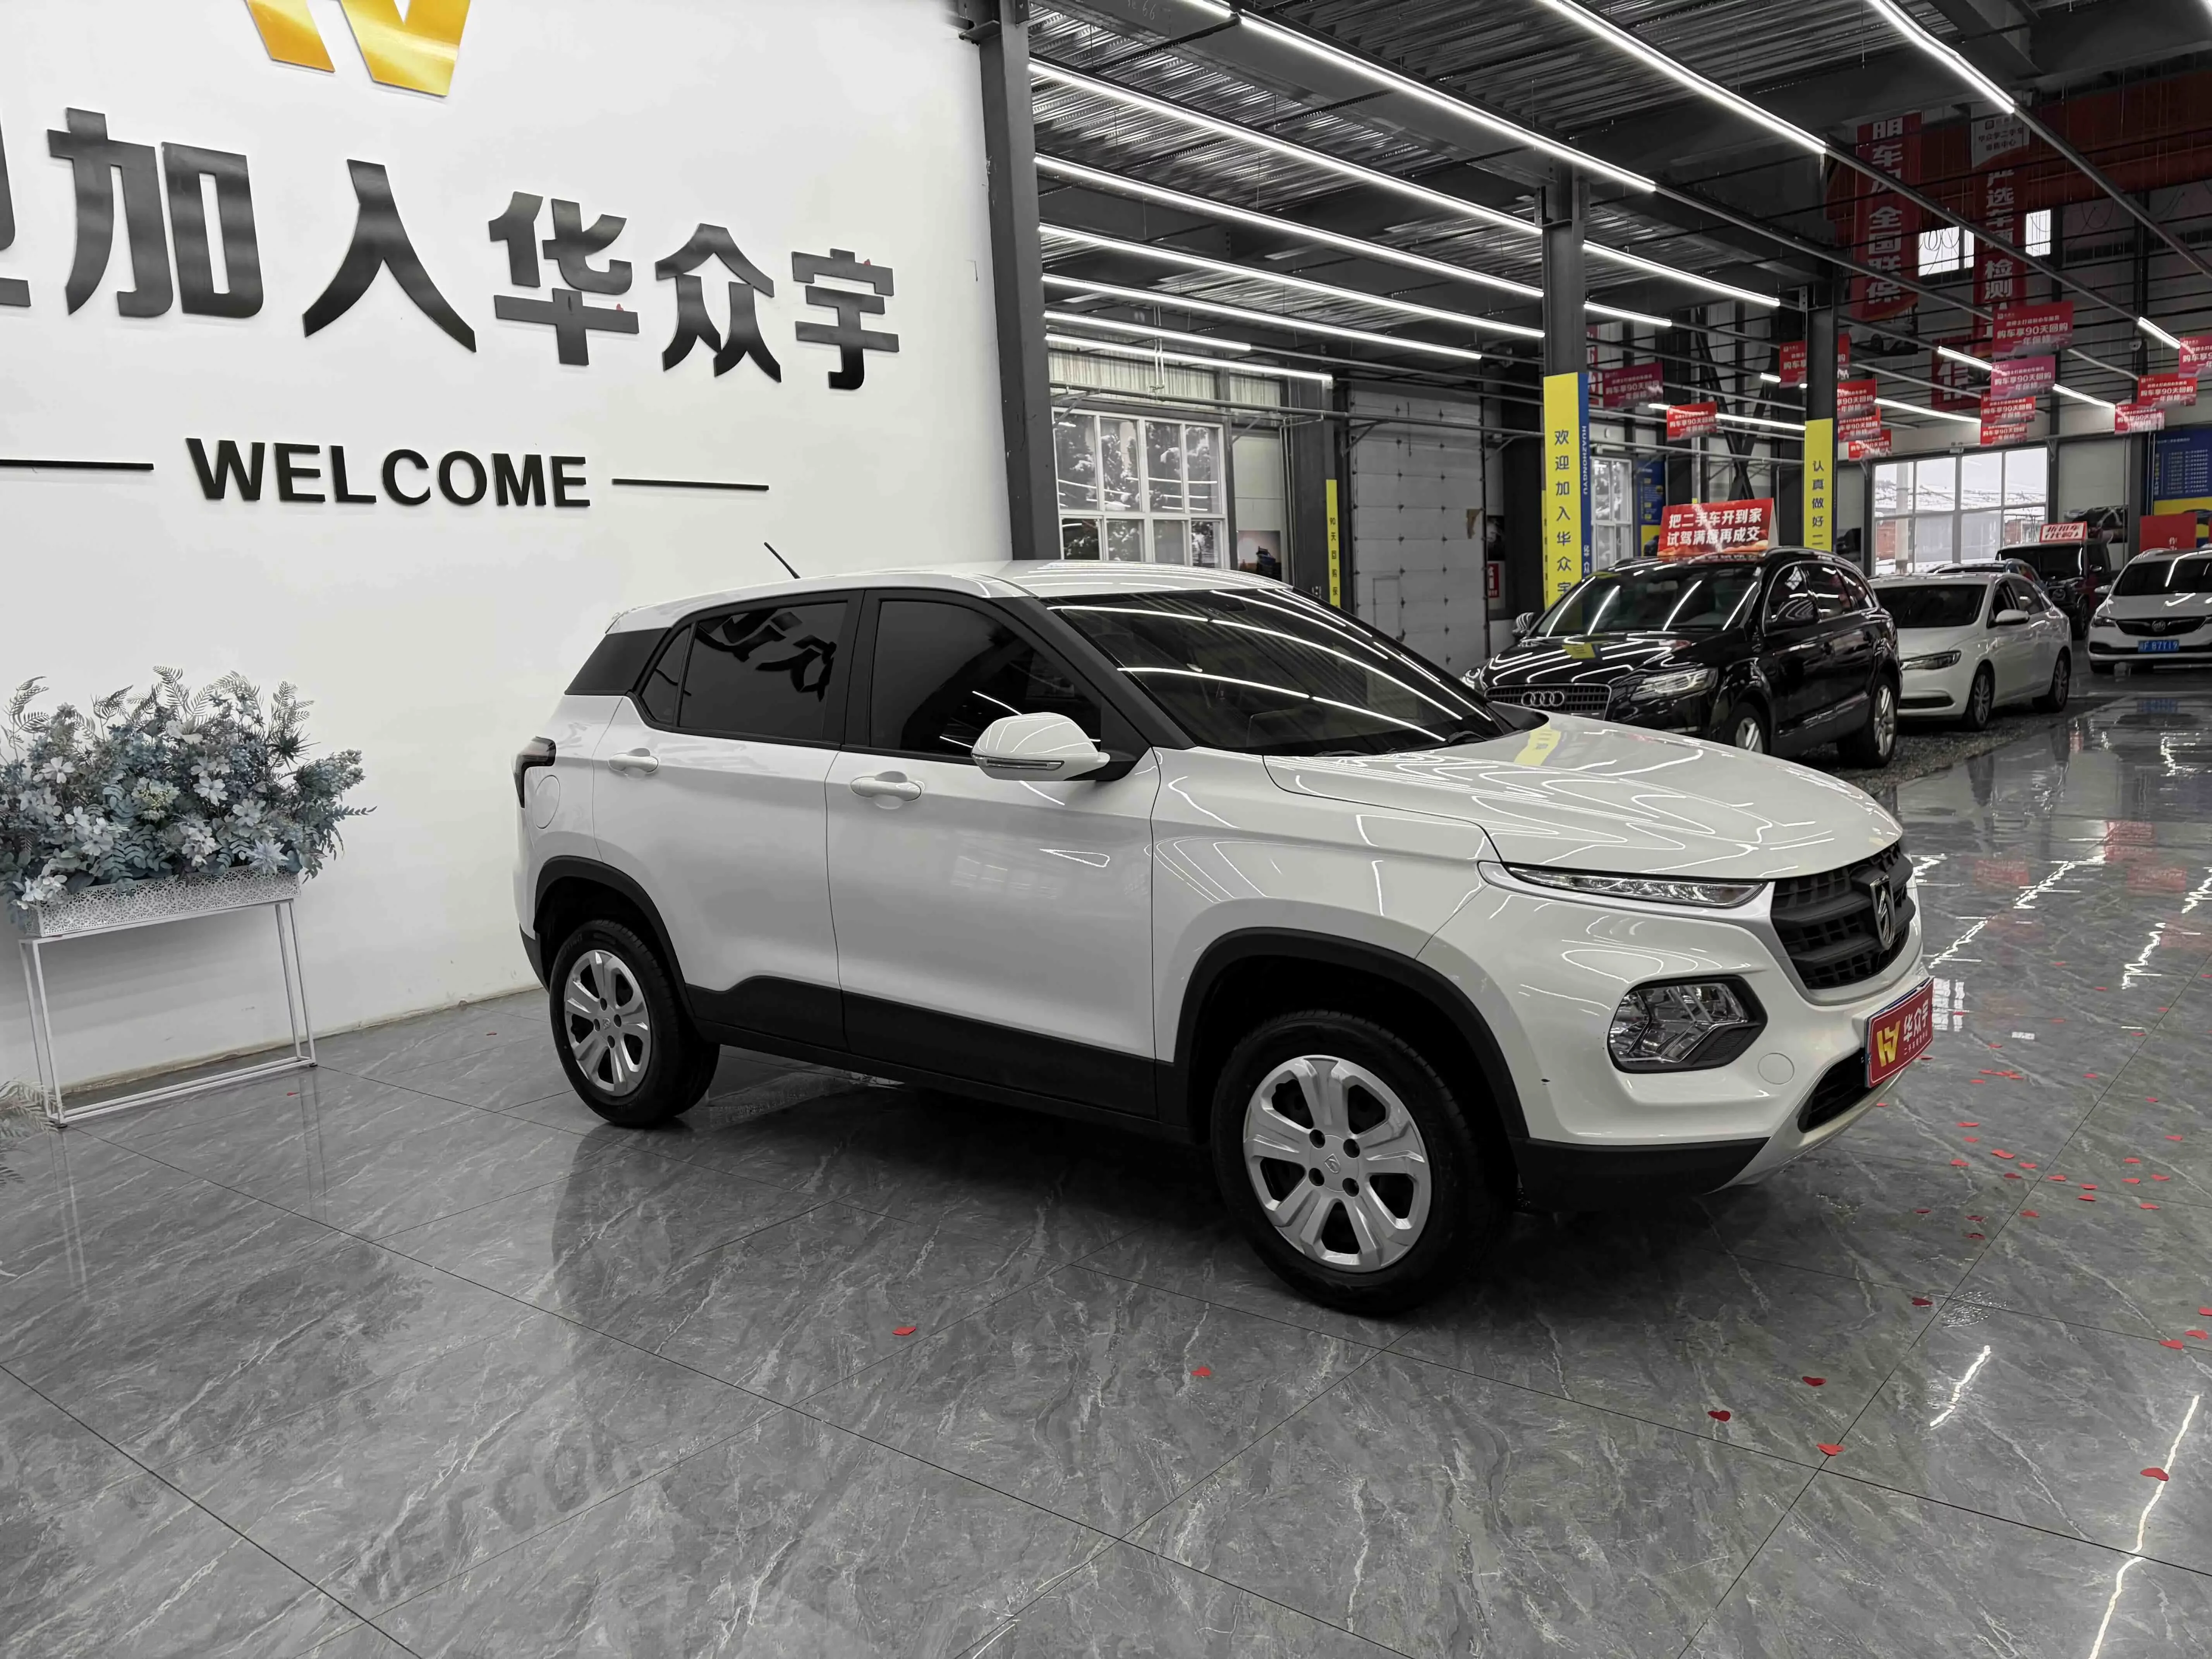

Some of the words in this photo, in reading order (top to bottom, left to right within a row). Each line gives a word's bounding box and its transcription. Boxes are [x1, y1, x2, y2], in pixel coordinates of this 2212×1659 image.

[1997, 322, 2068, 338] 购车享90天回购
[1994, 372, 2051, 386] 购车享90天回购
[186, 437, 591, 507] WELCOME
[1554, 429, 1571, 596] 欢迎加入华众宇
[1668, 508, 1762, 529] 把二手车开到家
[1812, 460, 1824, 545] 认真做好二
[1667, 526, 1760, 547] 试驾满意再成交
[1903, 999, 1929, 1042] 华众宇
